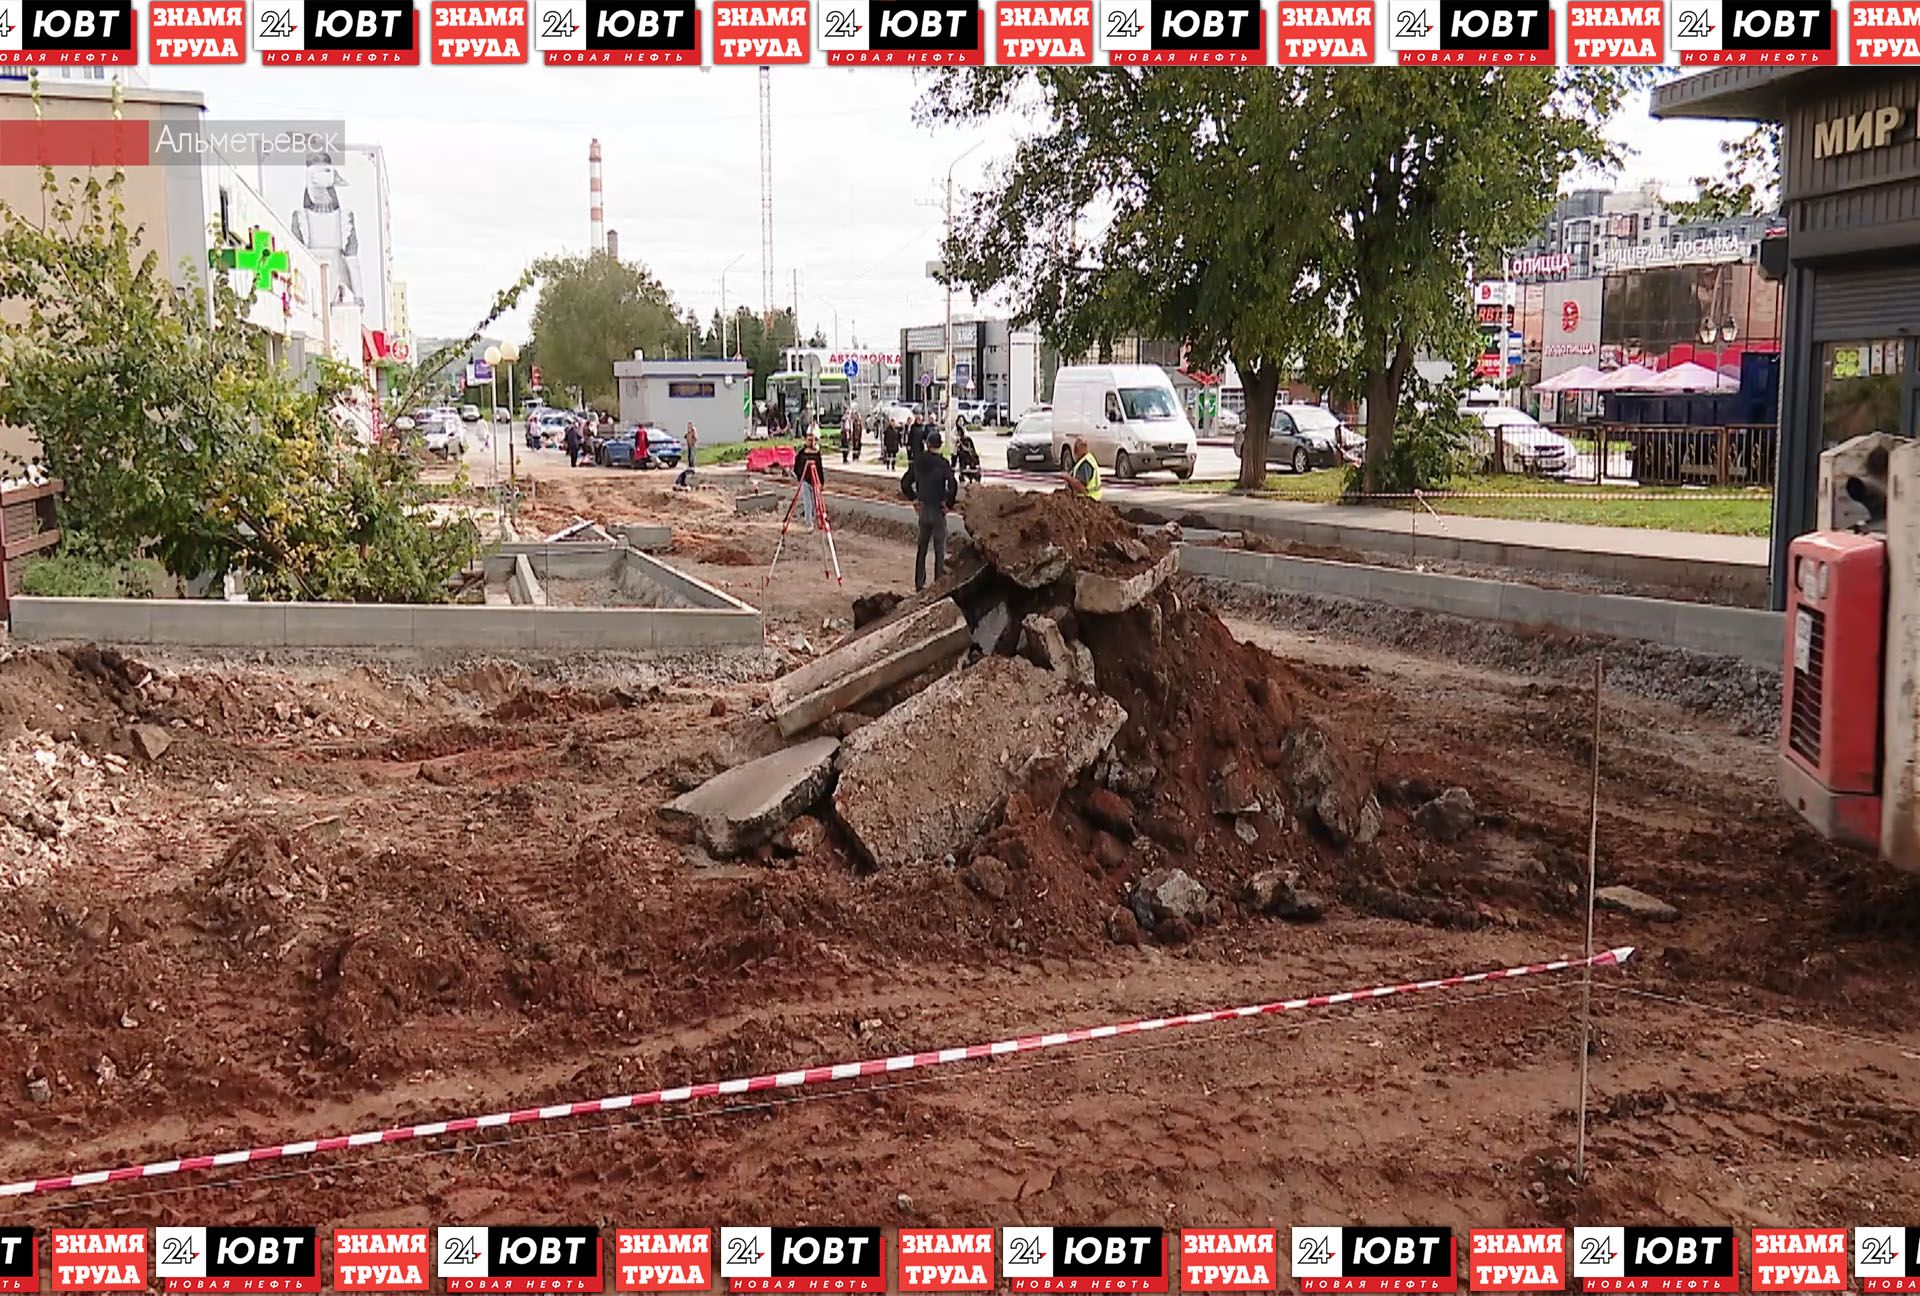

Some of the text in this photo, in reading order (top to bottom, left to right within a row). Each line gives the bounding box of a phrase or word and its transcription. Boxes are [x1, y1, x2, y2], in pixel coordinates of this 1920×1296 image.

[1814, 106, 1900, 159] МИР
[1512, 254, 1570, 275] ОПИЦЦА
[829, 353, 902, 365] АВТОМОЙКА
